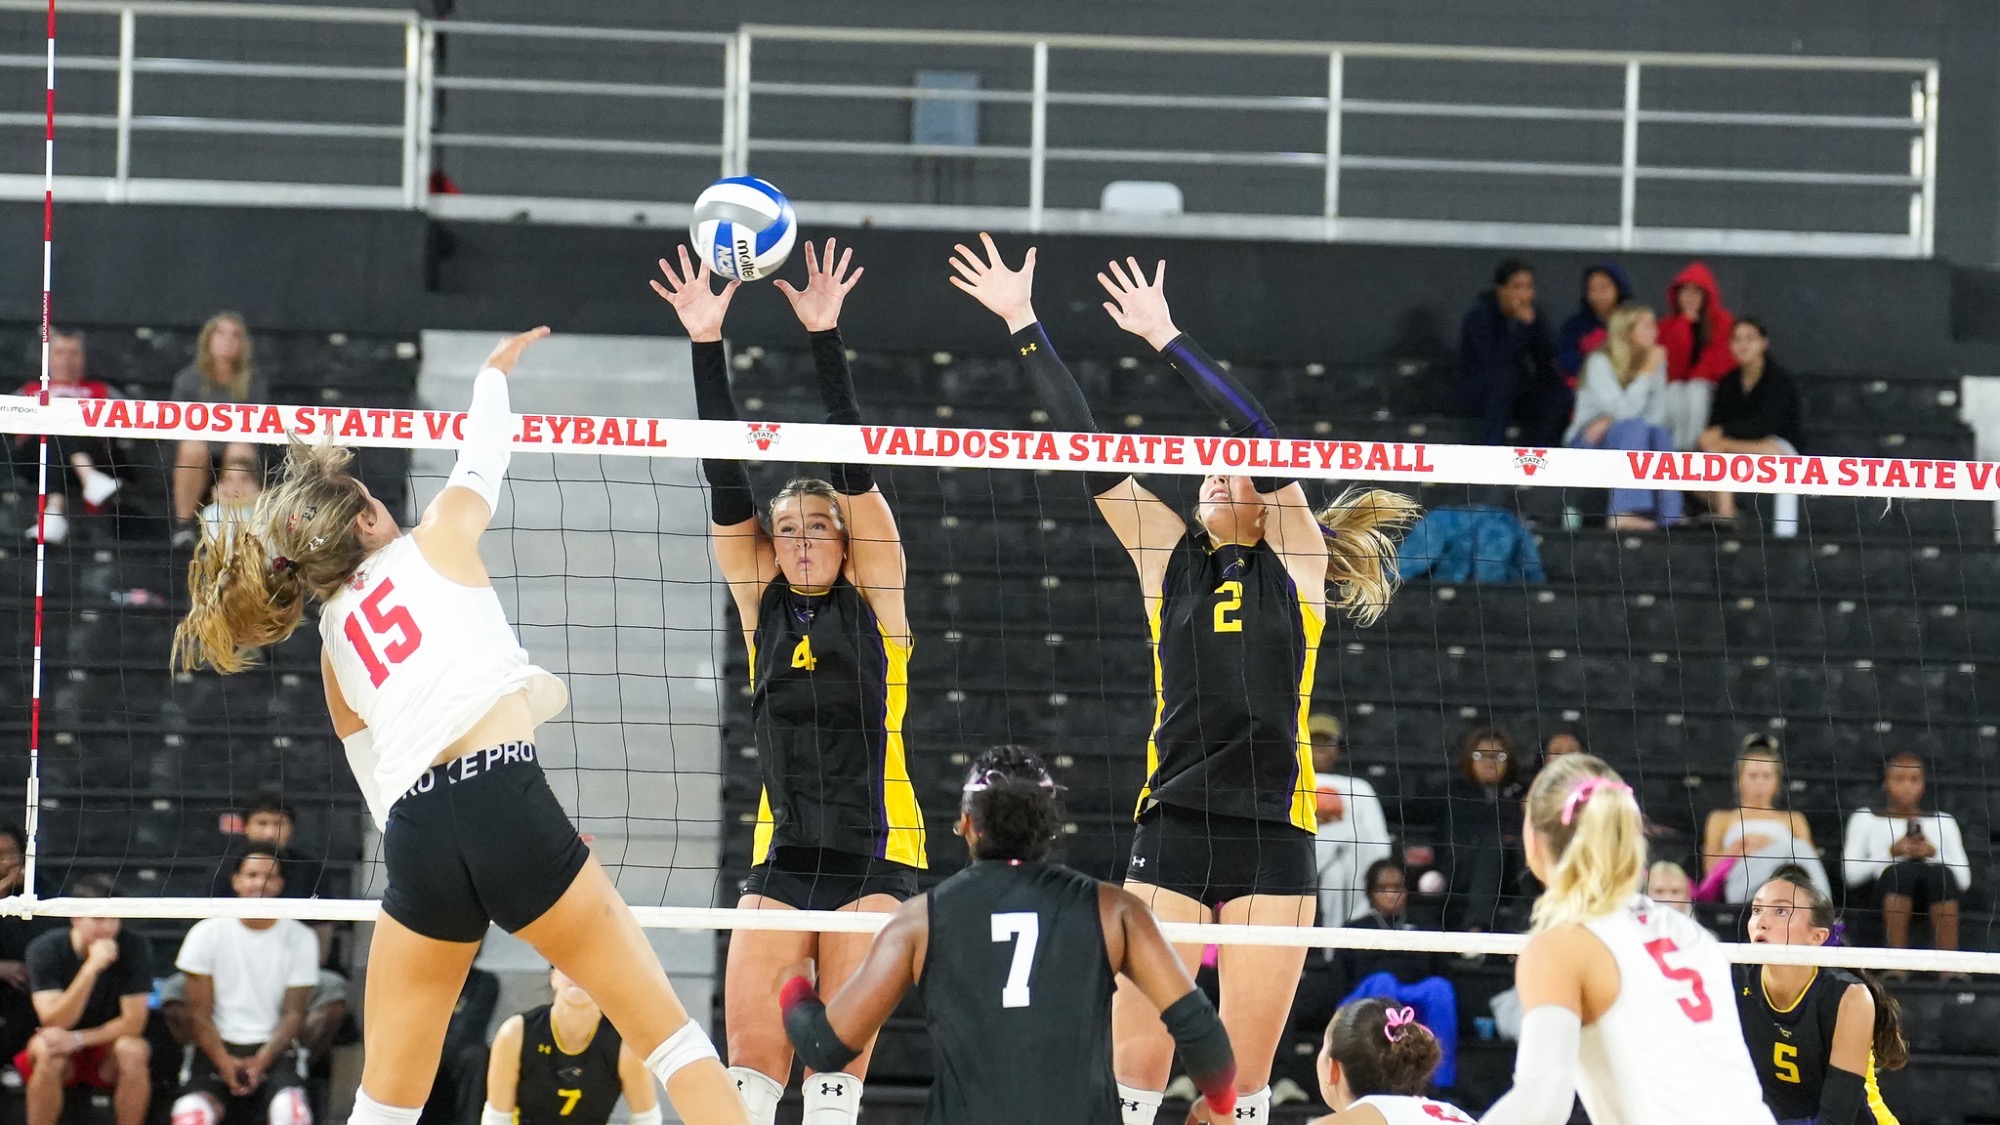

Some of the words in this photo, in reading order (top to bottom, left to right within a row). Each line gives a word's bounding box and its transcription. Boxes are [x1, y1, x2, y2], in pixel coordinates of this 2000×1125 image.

[78, 398, 285, 435] VALDOSTA
[294, 408, 414, 438] STATE
[424, 412, 667, 448] VOEYBALL
[860, 427, 1060, 461] VALDOSTA
[1069, 434, 1185, 465] STATE
[1194, 438, 1434, 472] VOLLEYBALL
[1627, 452, 1829, 485] VALDOSTA
[1838, 459, 1957, 489] STATE
[1966, 463, 2000, 490] V
[1214, 581, 1243, 632] 2
[344, 576, 422, 690] 15
[791, 635, 817, 671] 4
[485, 740, 534, 771] PRO
[991, 912, 1039, 1008] 7
[1644, 938, 1713, 1023] 5
[1773, 1042, 1800, 1083] 5
[557, 1088, 582, 1116] 7
